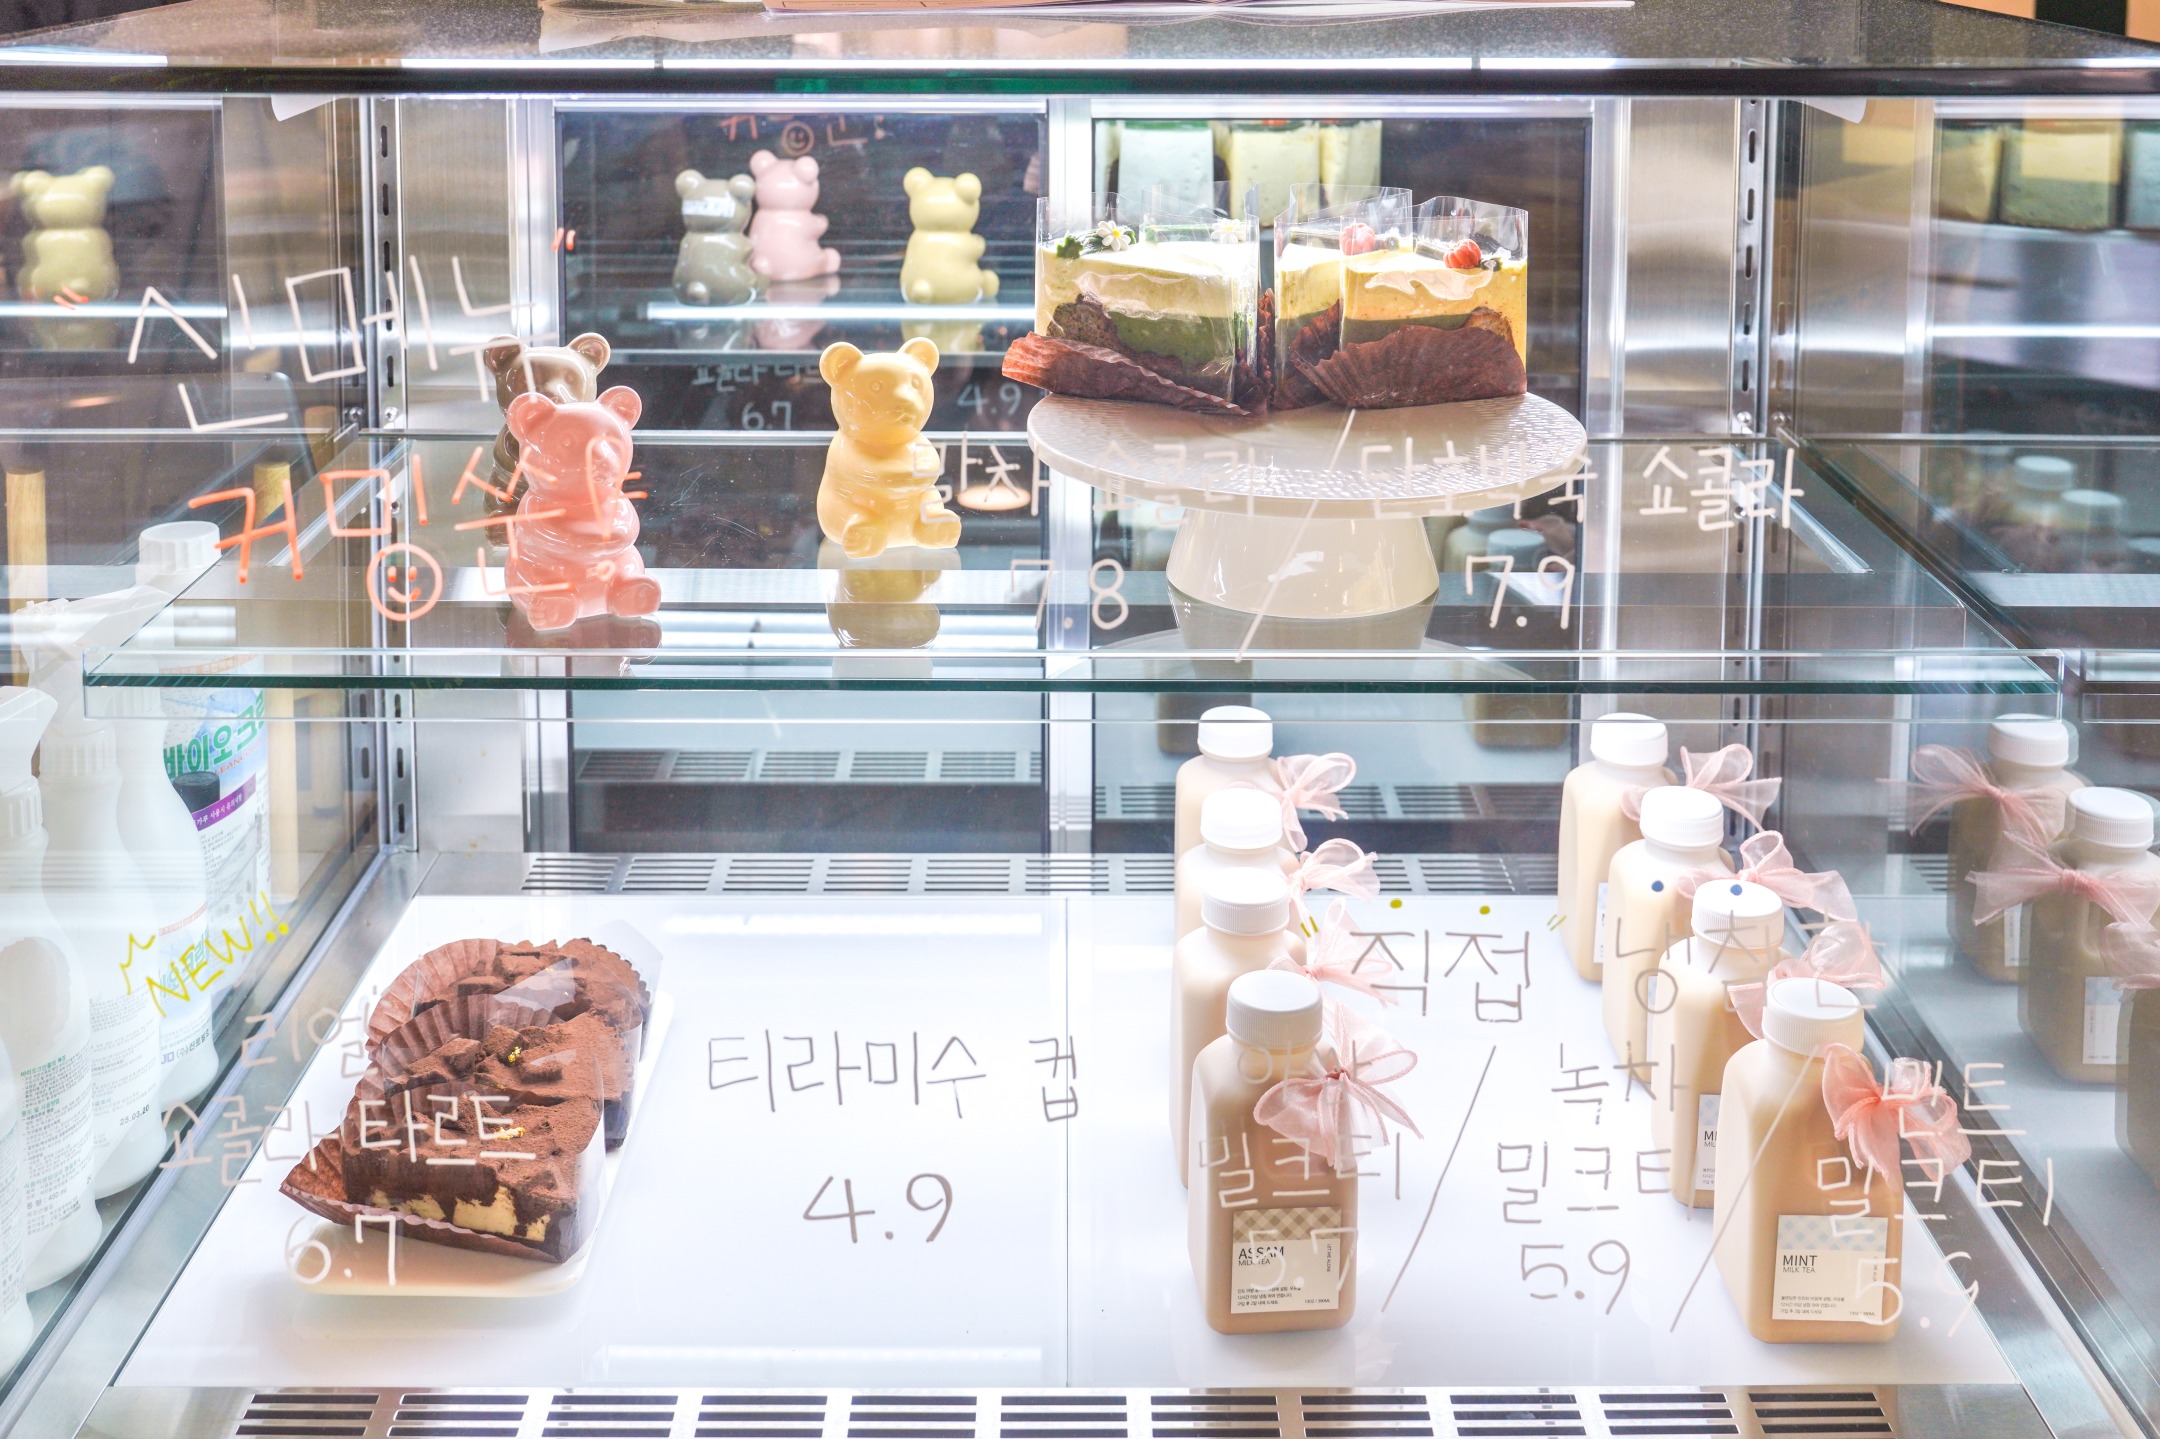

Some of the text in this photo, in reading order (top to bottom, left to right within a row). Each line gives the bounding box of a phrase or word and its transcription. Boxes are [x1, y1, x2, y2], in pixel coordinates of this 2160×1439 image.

[127, 254, 559, 433] 신메뉴
[957, 382, 1023, 416] 4.9
[1639, 445, 1805, 532] 쇼콜라
[1010, 557, 1130, 631] 7.8
[1465, 554, 1576, 630] 7.9
[1349, 928, 1532, 1023] 직접
[708, 1028, 1079, 1122] 티라미수 컵
[1551, 1040, 1690, 1126] 녹차
[1881, 1060, 2027, 1138] 민트
[159, 1093, 341, 1188] 쇼콜라
[358, 1089, 537, 1166] 타르트
[1199, 1131, 1402, 1209] 밀크티
[802, 1172, 954, 1244] 4.9
[1497, 1140, 1698, 1224] 밀크티
[1816, 1156, 2054, 1238] 밀크티
[284, 1211, 400, 1287] 6.7
[1248, 1226, 1359, 1292] 5.7
[1520, 1239, 1631, 1316] 5.9
[1782, 1254, 1818, 1267] MINT
[1802, 1266, 1816, 1274] TEA
[1855, 1251, 1980, 1338] 5.9
